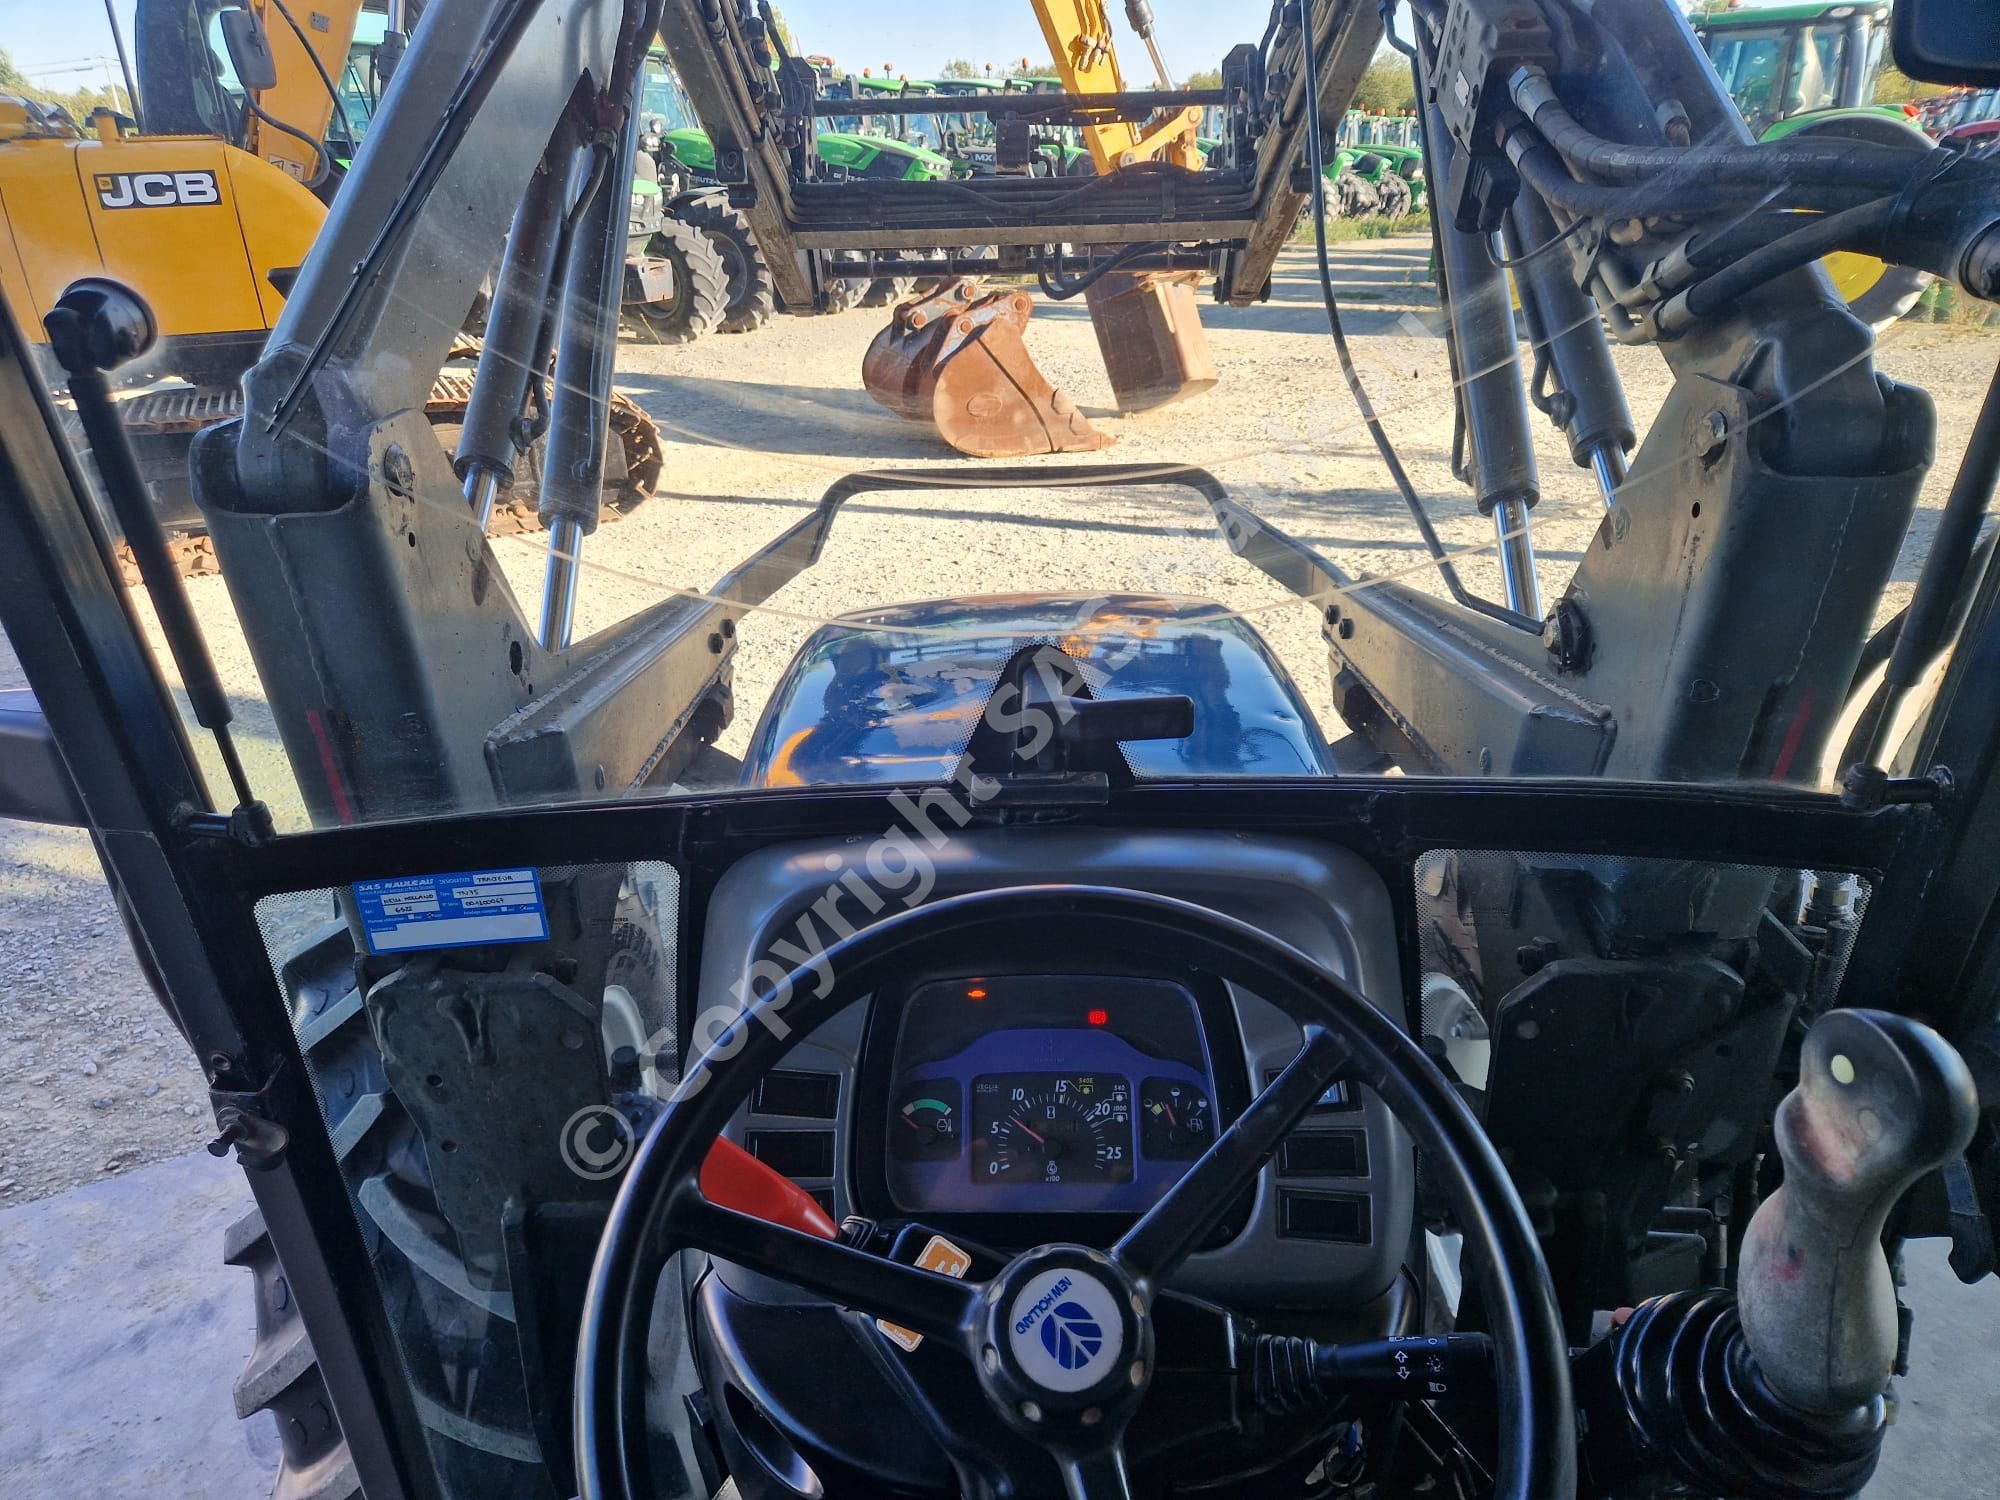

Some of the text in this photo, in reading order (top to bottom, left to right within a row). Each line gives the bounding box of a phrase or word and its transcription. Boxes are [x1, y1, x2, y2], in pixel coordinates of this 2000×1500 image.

[974, 153, 993, 162] MX
[100, 173, 218, 207] JCB
[1055, 1080, 1067, 1093] 15
[1011, 1088, 1025, 1101] 10
[1094, 1103, 1111, 1116] 20
[990, 1122, 999, 1134] 5
[1106, 1147, 1122, 1160] 25
[989, 1162, 998, 1175] 0
[1015, 1276, 1073, 1335] NEW HOLLAND
